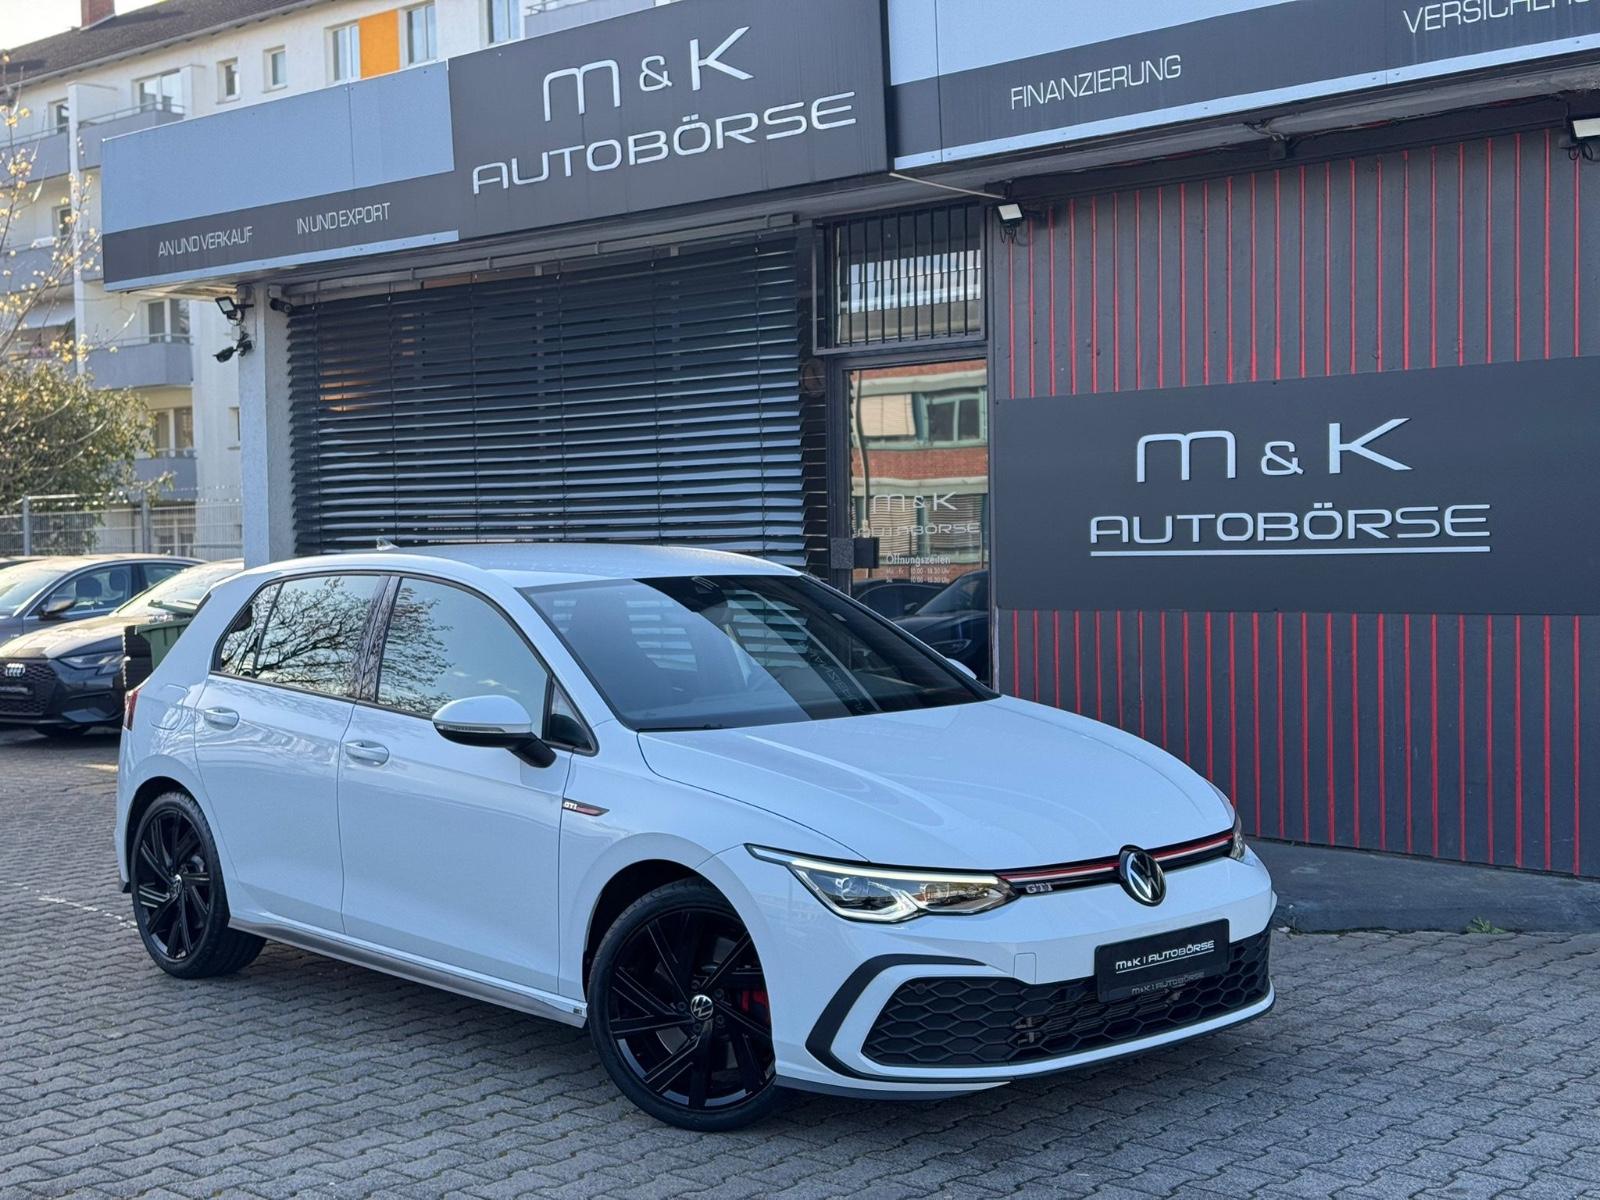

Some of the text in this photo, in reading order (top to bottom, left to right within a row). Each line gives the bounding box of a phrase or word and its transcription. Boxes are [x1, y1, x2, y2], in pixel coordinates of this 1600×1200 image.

[1402, 0, 1592, 34] VERSICH
[639, 54, 673, 92] &
[689, 26, 755, 91] K
[1010, 54, 1182, 110] FINANZIERUNG
[472, 91, 857, 195] AUTOBÖRSE
[310, 211, 338, 233] UND
[339, 202, 391, 228] EXPORT
[174, 236, 200, 254] UND
[200, 226, 253, 251] VERKAUF
[1260, 440, 1304, 476] &
[1328, 417, 1414, 474] K
[933, 491, 958, 511] K
[1090, 502, 1491, 544] AUTOBÖRSE
[563, 801, 577, 810] GTI
[1025, 882, 1054, 895] GTI
[1148, 940, 1215, 963] AUTOBÖRSE
